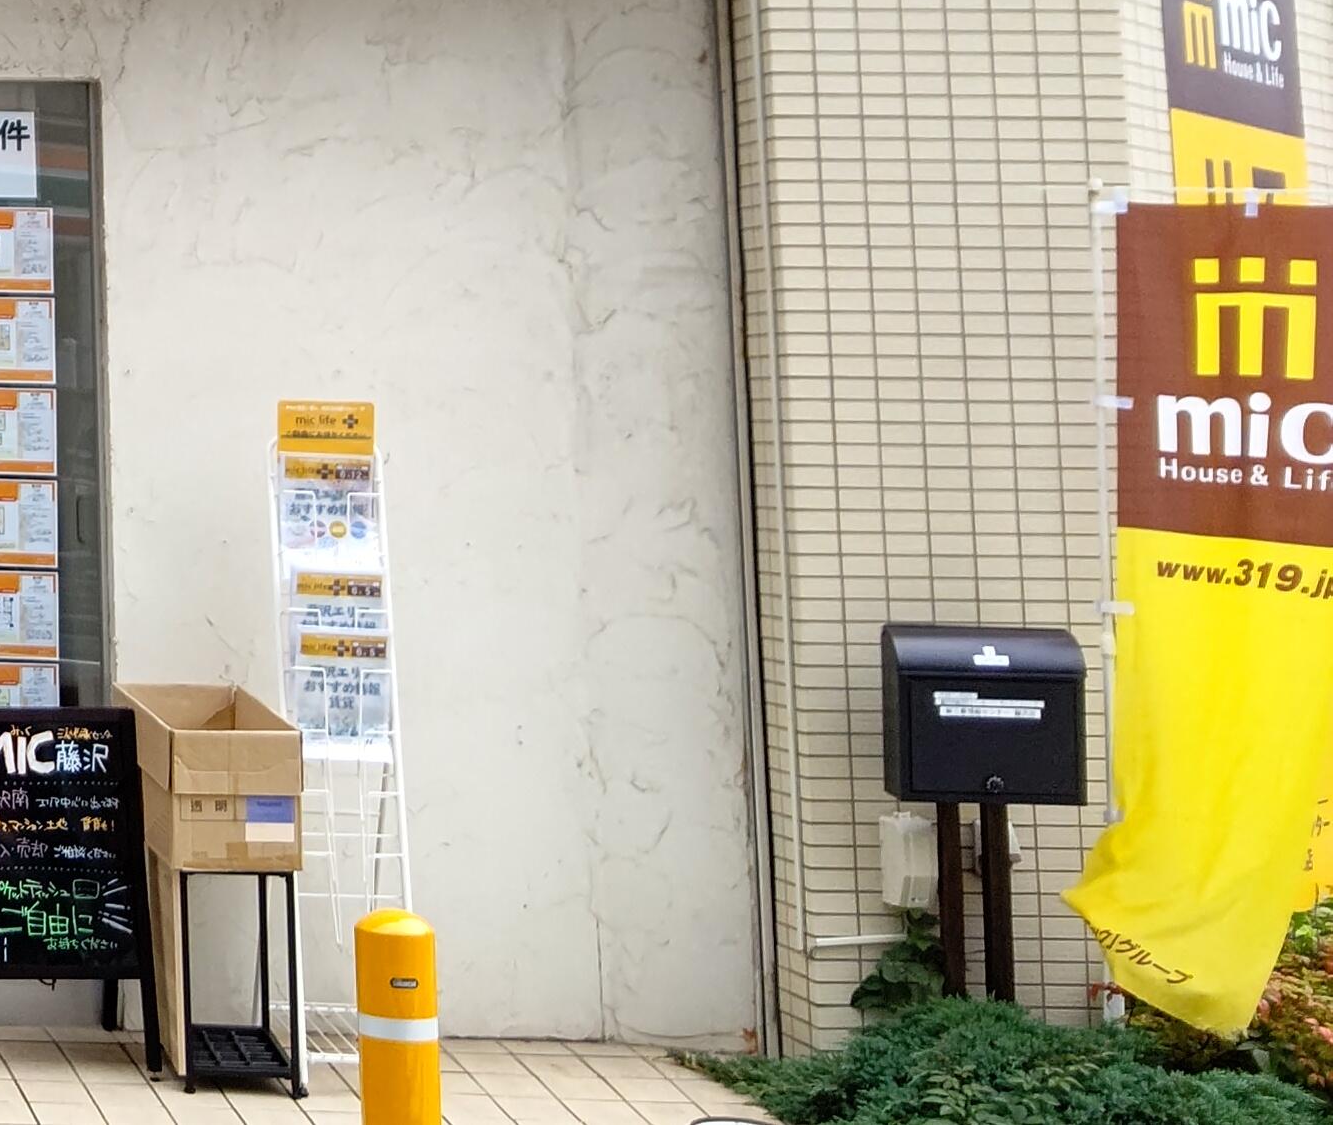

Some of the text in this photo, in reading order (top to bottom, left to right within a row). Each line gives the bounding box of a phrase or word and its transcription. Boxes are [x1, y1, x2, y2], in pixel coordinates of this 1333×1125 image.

[1265, 62, 1285, 89] Life
[295, 415, 337, 427] mic life
[1159, 457, 1244, 484] House
[1250, 464, 1270, 486] &
